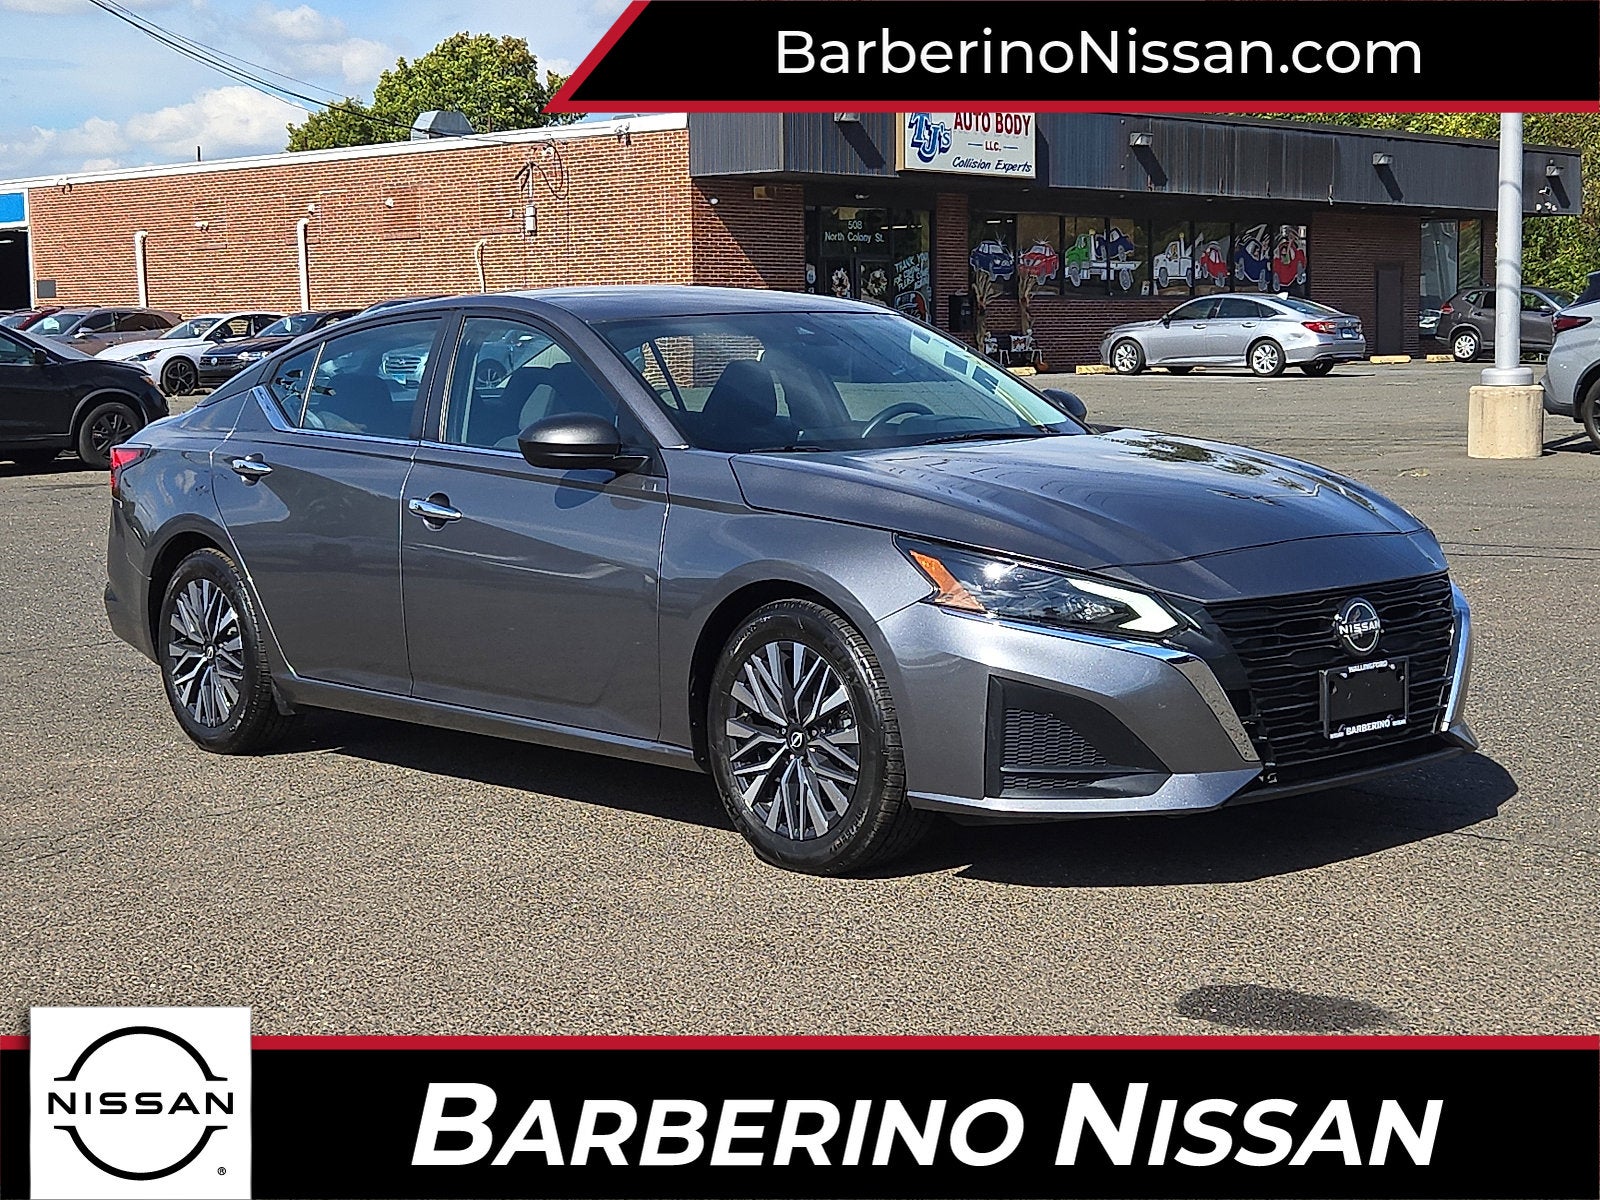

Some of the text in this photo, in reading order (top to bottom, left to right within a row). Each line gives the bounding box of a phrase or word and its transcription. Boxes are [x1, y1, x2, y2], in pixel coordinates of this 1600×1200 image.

[954, 112, 1031, 136] AUTO BODY
[952, 157, 1033, 173] Collision Experts
[847, 220, 863, 230] 508
[824, 231, 845, 242] North
[847, 231, 872, 243] Colony
[1338, 620, 1381, 635] NISSAN
[1345, 719, 1391, 735] BARBERINO
